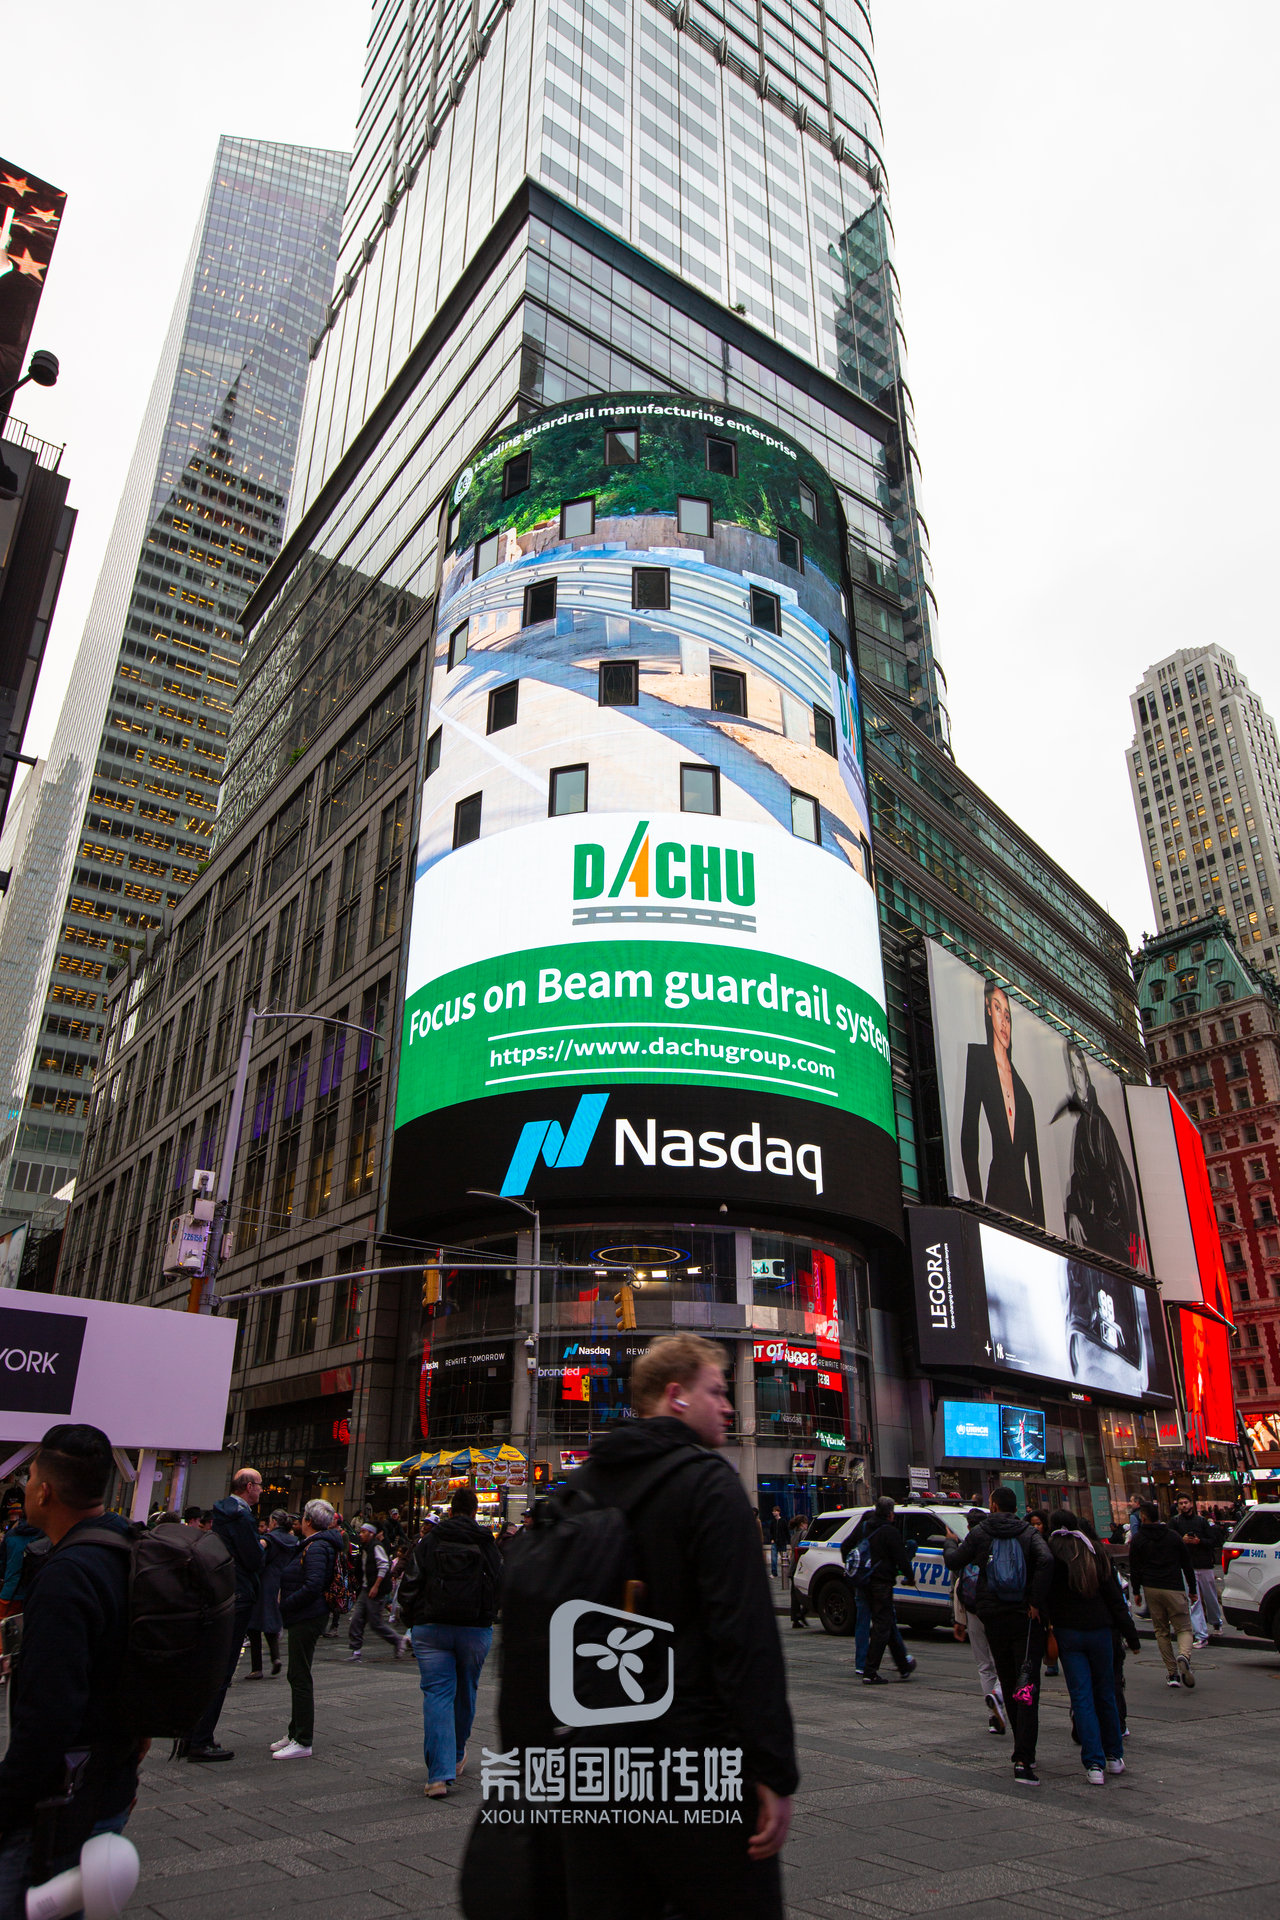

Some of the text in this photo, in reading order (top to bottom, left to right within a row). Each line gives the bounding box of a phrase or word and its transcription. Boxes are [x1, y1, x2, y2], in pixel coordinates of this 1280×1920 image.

[475, 403, 798, 472] Leading guardrail manufacturing enterprise
[573, 821, 755, 906] DACHU
[408, 991, 476, 1045] Focus
[484, 981, 525, 1012] on
[539, 968, 652, 1004] Beam
[665, 970, 830, 1026] guardrail
[489, 1037, 835, 1079] https://www.dachugroup.com
[615, 1119, 824, 1196] Nasdaq
[925, 1243, 948, 1328] LEGORA
[445, 1358, 467, 1367] REWRITE
[469, 1353, 506, 1363] TOMORROW
[578, 1346, 611, 1356] Nasdaq
